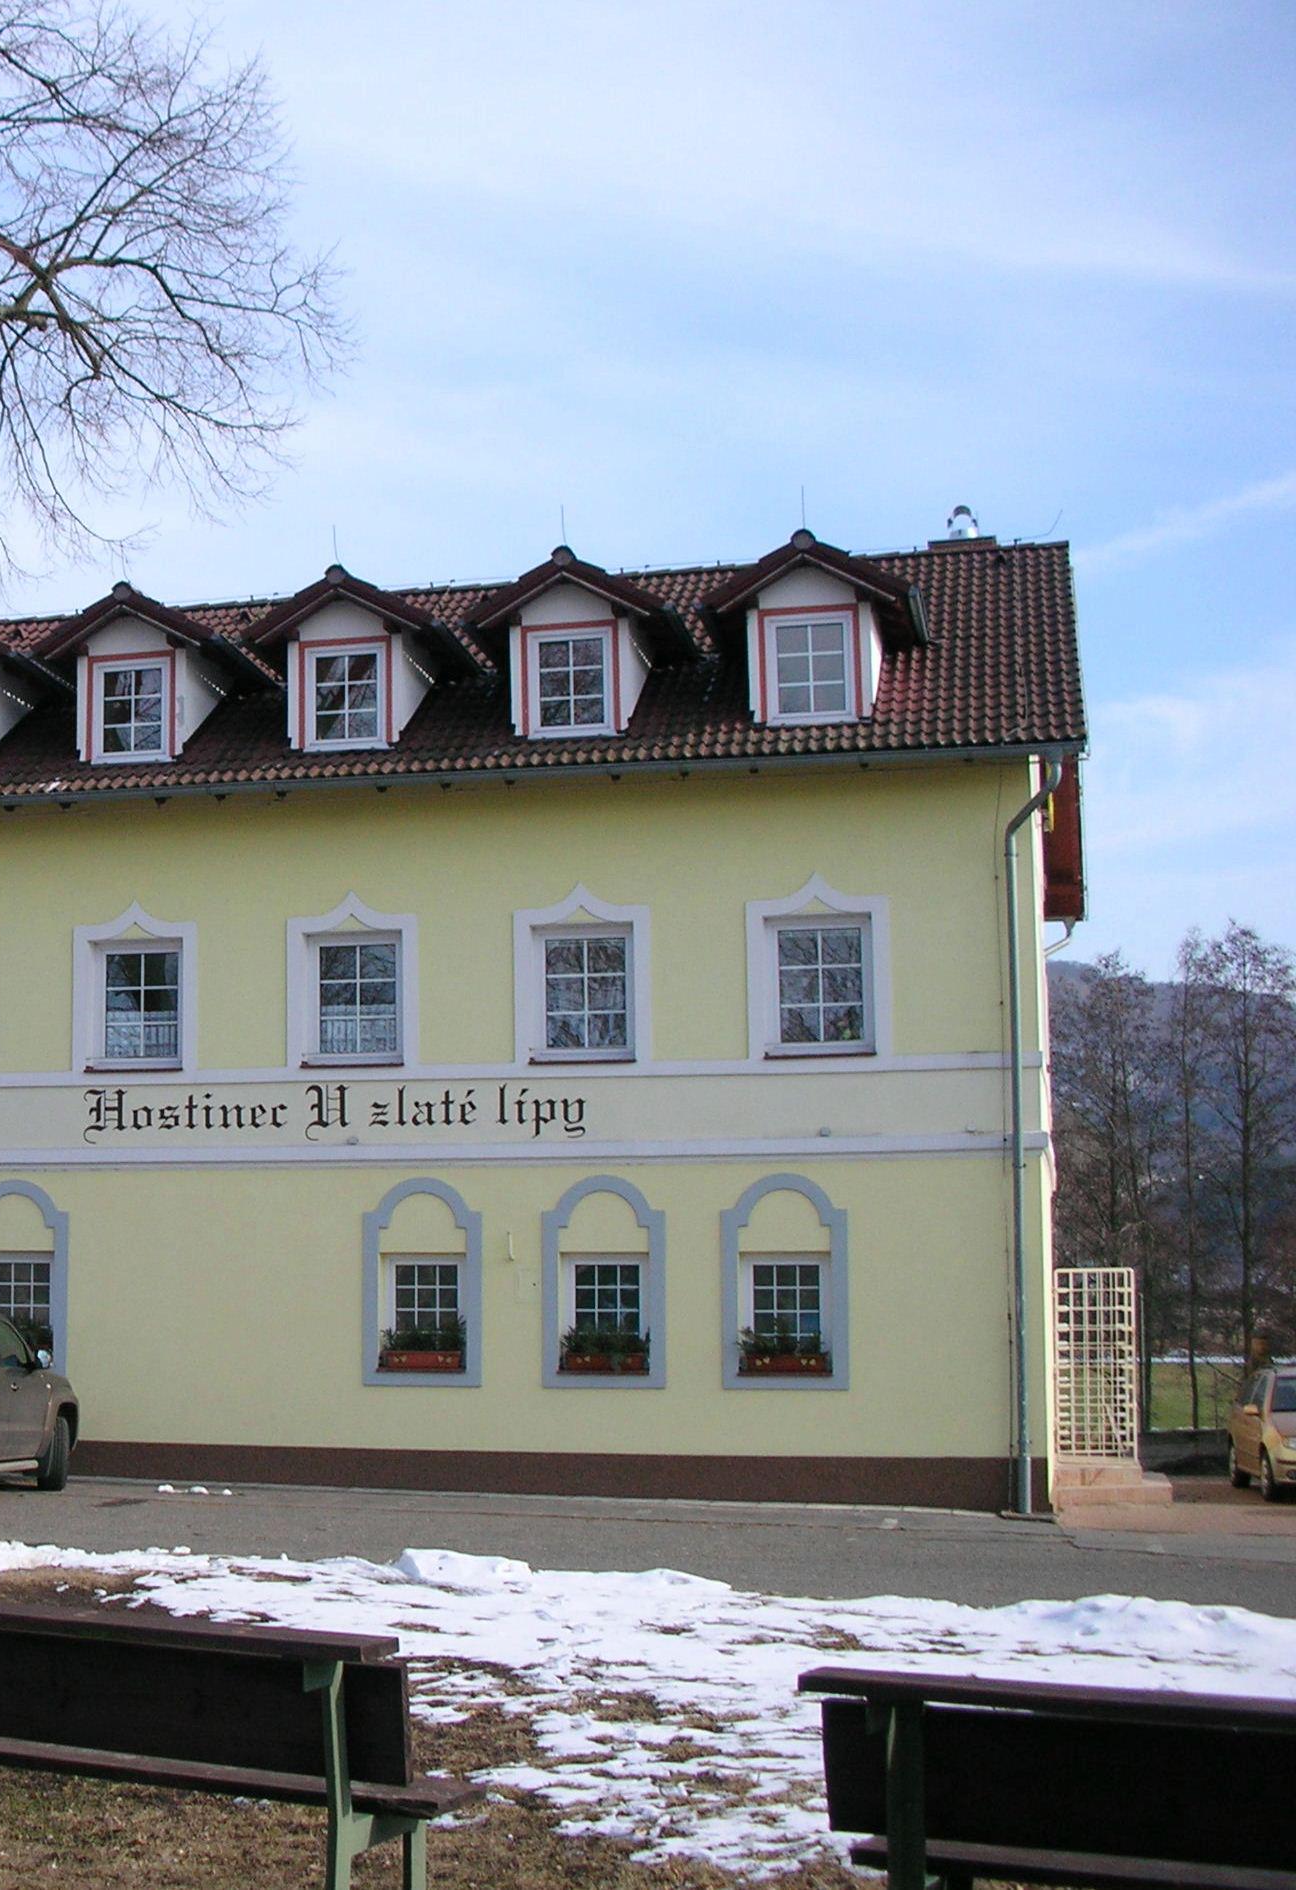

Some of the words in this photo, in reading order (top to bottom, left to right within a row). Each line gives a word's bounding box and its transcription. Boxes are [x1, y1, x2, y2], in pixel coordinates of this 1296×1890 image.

[83, 1088, 288, 1144] Hostinec
[305, 1083, 351, 1141] U
[368, 1085, 478, 1127] zlaté
[496, 1082, 587, 1139] lípy
